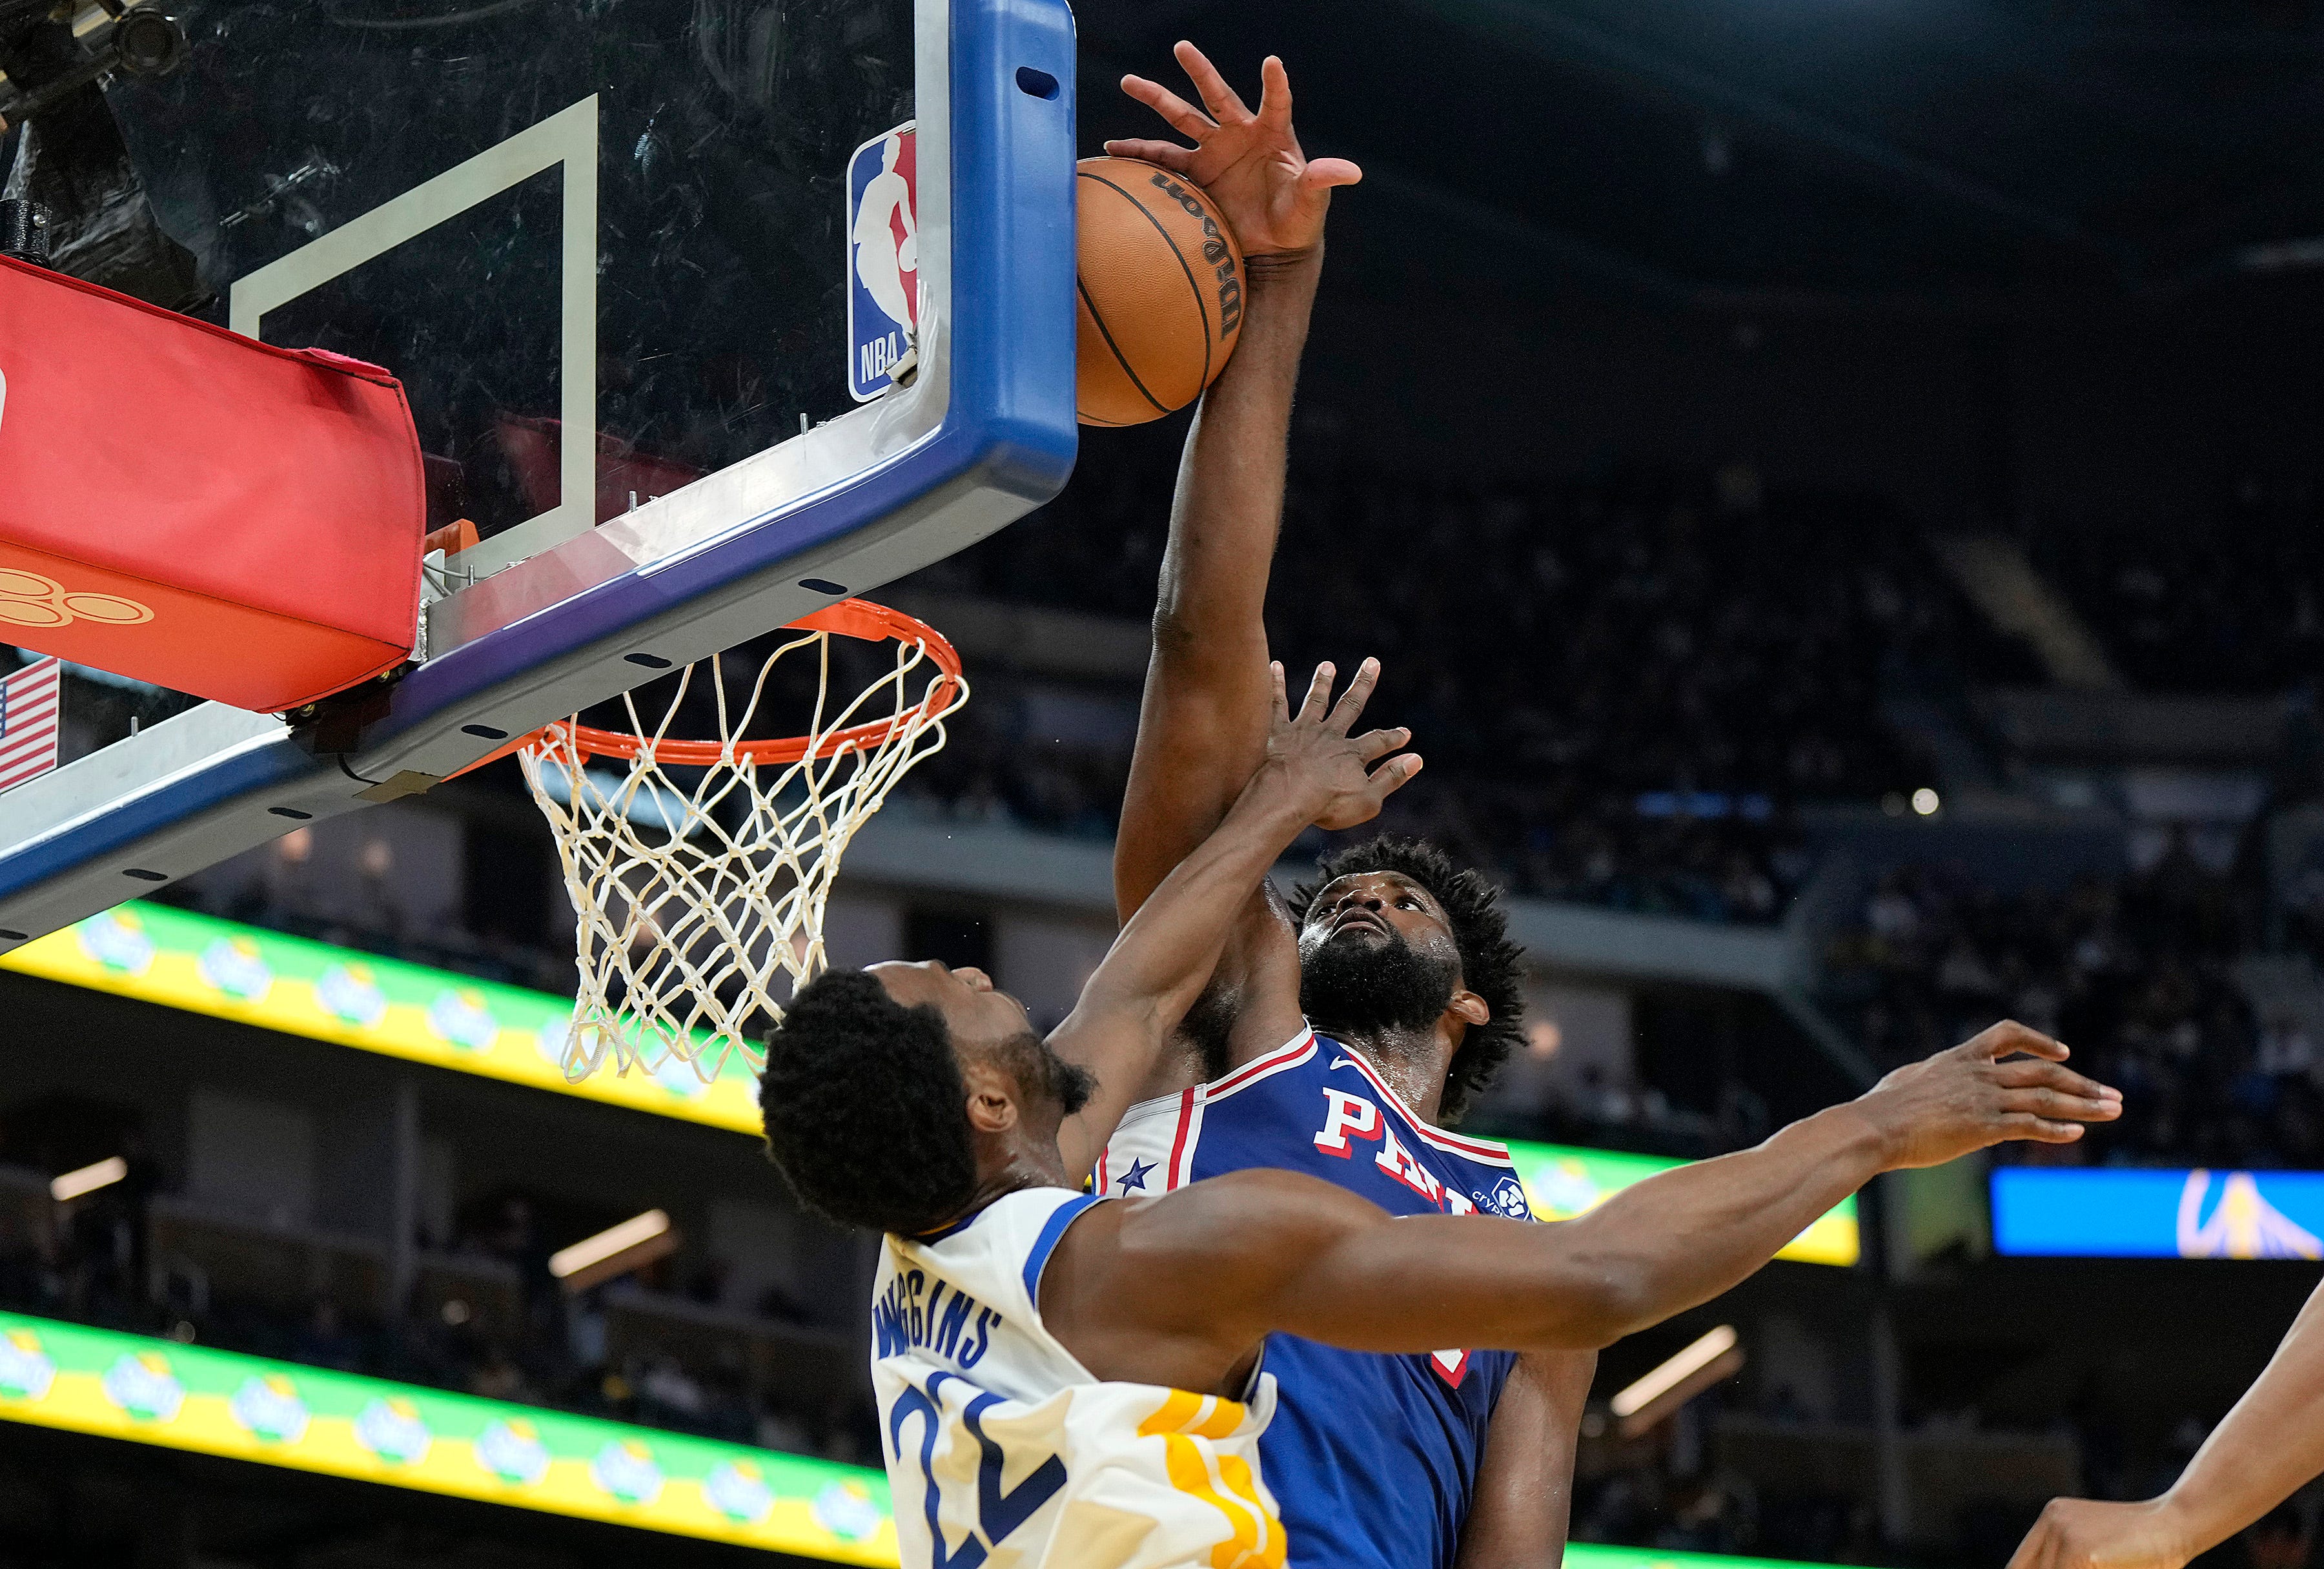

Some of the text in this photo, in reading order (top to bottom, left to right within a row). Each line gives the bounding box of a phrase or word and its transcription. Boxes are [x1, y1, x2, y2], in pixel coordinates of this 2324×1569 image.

[861, 331, 898, 384] NBA
[1472, 1191, 1503, 1217] cryp
[890, 1371, 1067, 1569] 22
